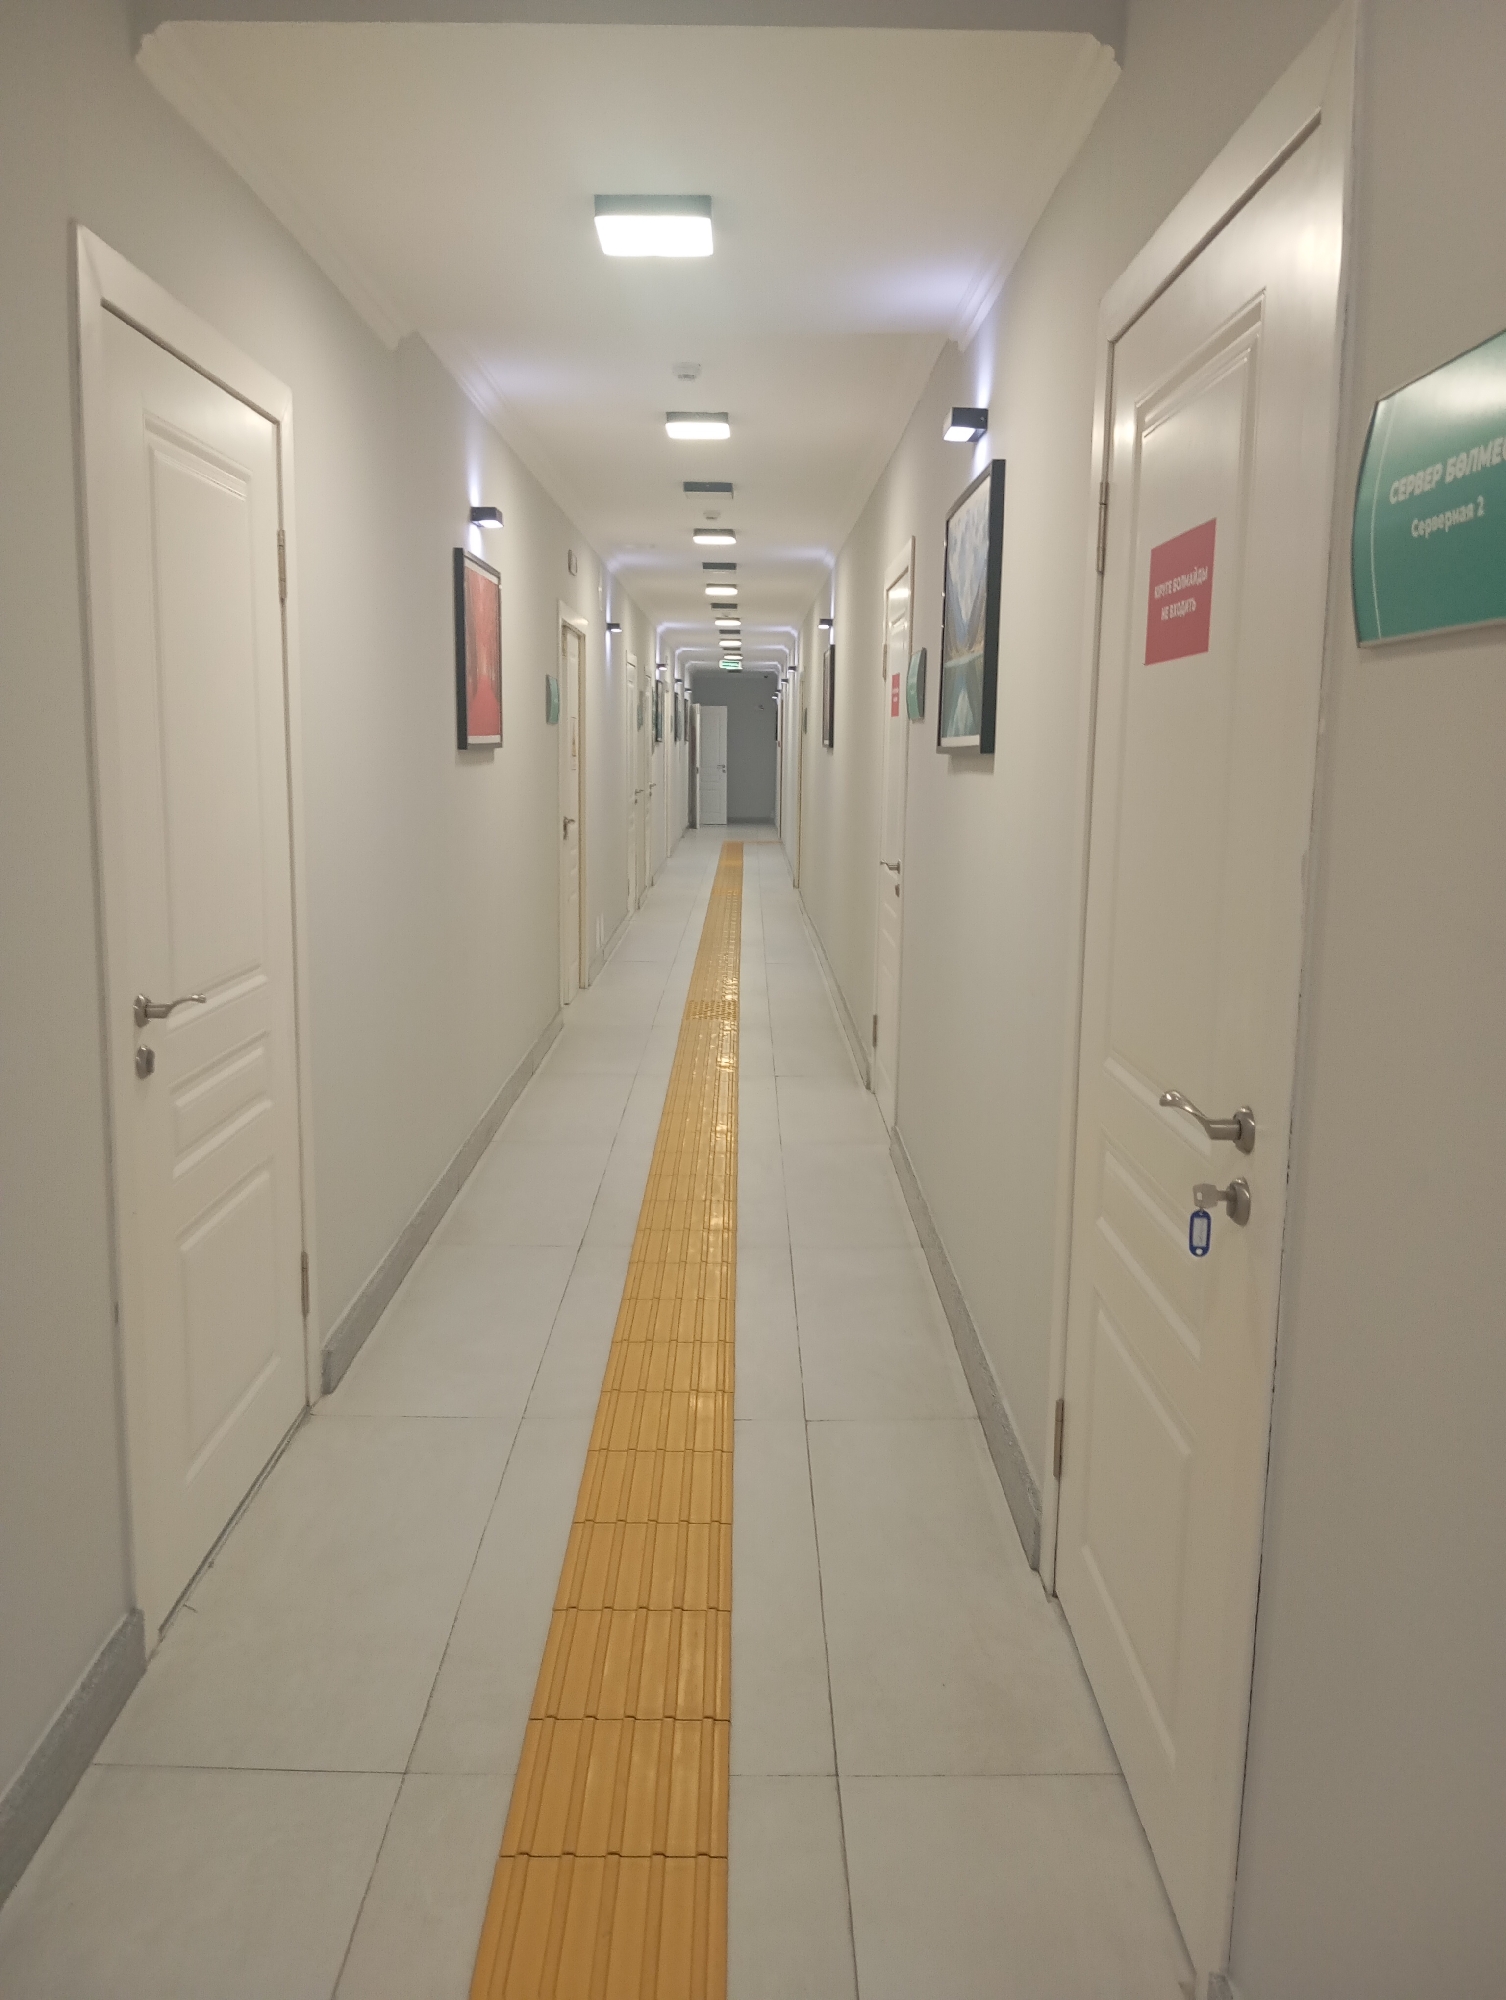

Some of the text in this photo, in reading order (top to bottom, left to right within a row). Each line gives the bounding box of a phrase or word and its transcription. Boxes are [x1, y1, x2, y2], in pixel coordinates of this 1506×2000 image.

[1390, 463, 1443, 504] СЕРВЕР
[1411, 495, 1484, 539] Серверная 2
[1161, 598, 1196, 620] НЕ ВХОДИТЬ
